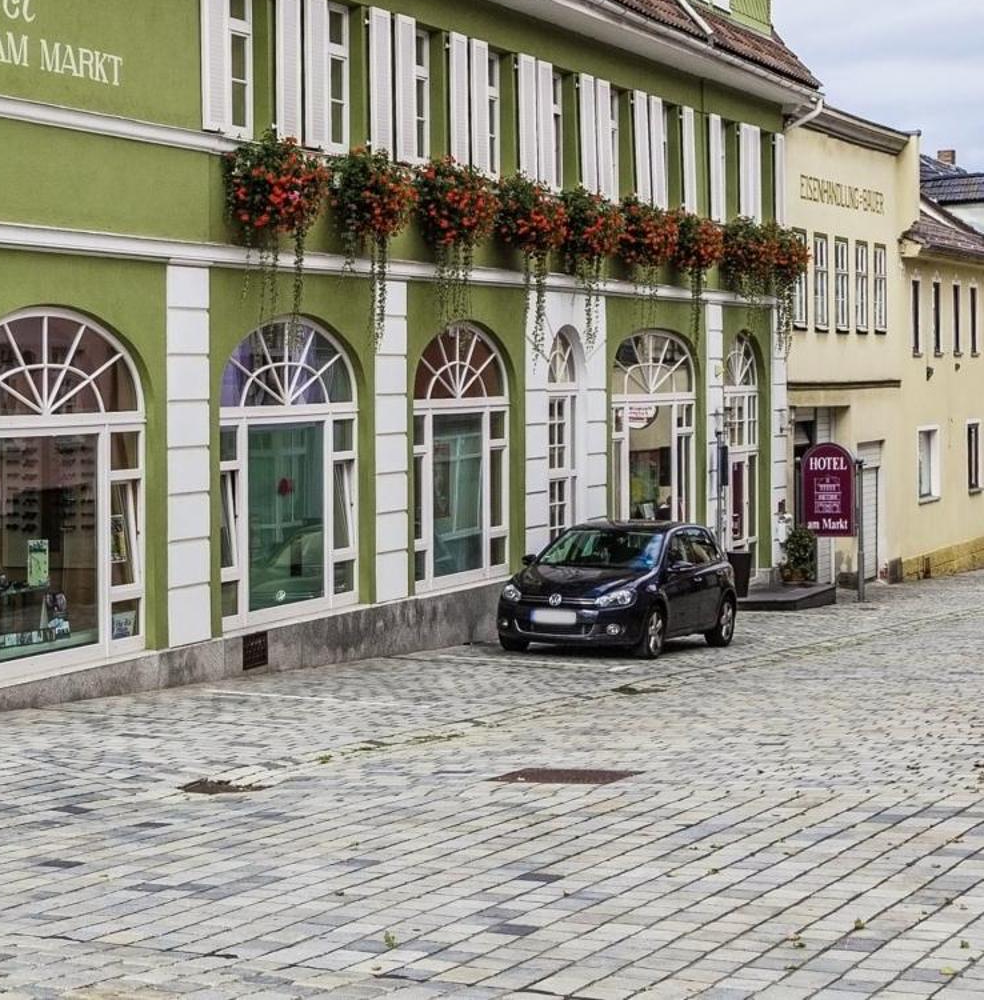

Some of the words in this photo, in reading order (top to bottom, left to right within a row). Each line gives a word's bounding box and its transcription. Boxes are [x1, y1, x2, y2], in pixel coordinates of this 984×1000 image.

[40, 39, 124, 86] MARKT
[809, 457, 848, 470] HOTEL
[807, 521, 820, 530] am
[822, 518, 848, 530] Markt
